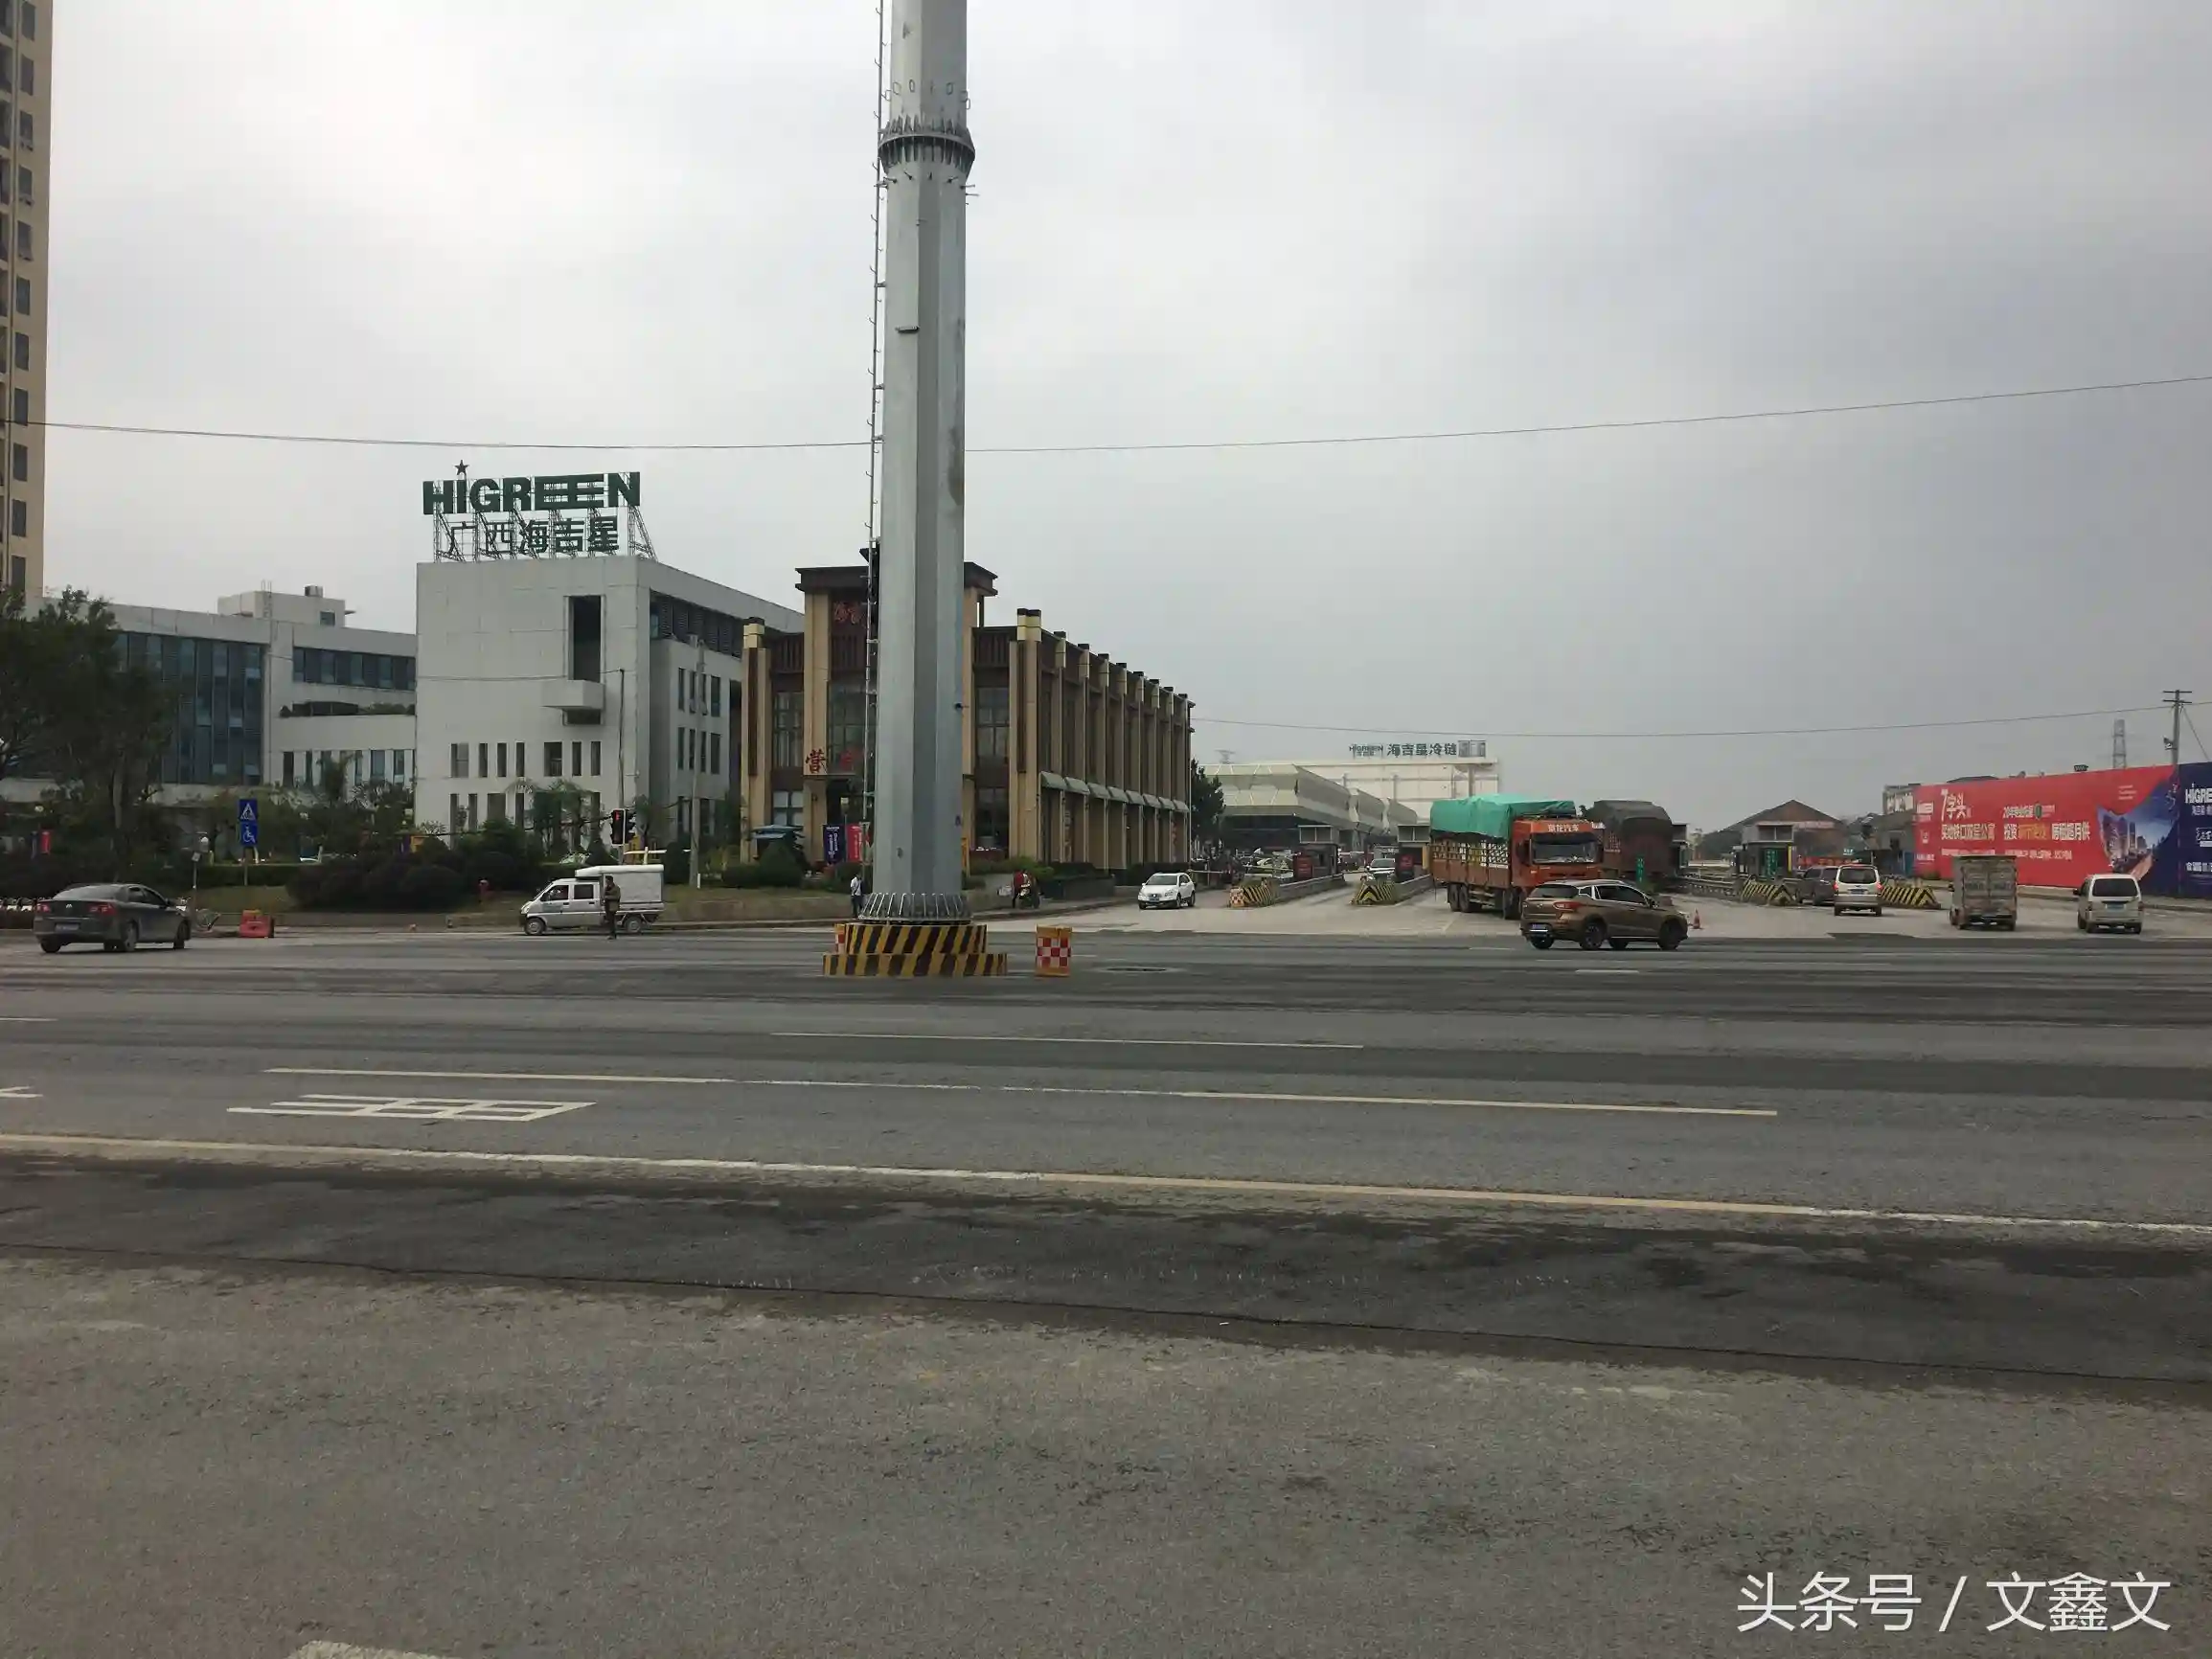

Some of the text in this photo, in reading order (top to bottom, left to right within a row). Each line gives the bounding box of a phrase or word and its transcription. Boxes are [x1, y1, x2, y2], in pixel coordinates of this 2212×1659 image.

[422, 471, 640, 514] HIGREEN
[447, 515, 620, 555] 广西海吉星
[1386, 742, 1457, 758] 海吉星冷链
